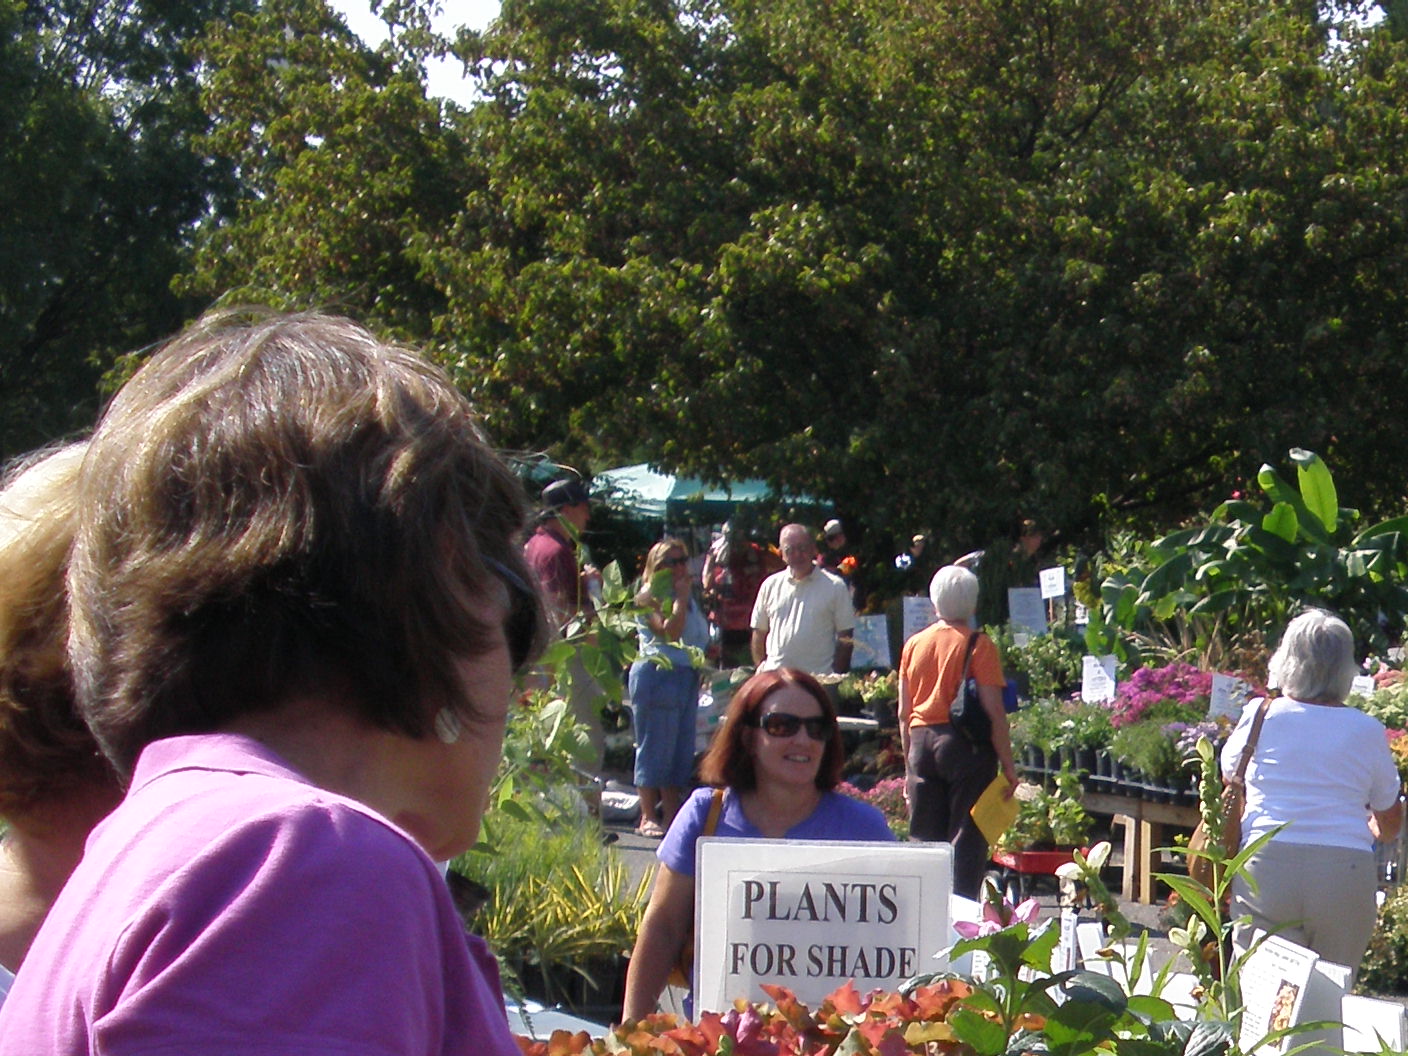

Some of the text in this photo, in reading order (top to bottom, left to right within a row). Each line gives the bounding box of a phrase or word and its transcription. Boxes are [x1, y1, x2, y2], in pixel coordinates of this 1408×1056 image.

[741, 880, 898, 924] PLANTS
[729, 942, 917, 979] FOR SHADE
